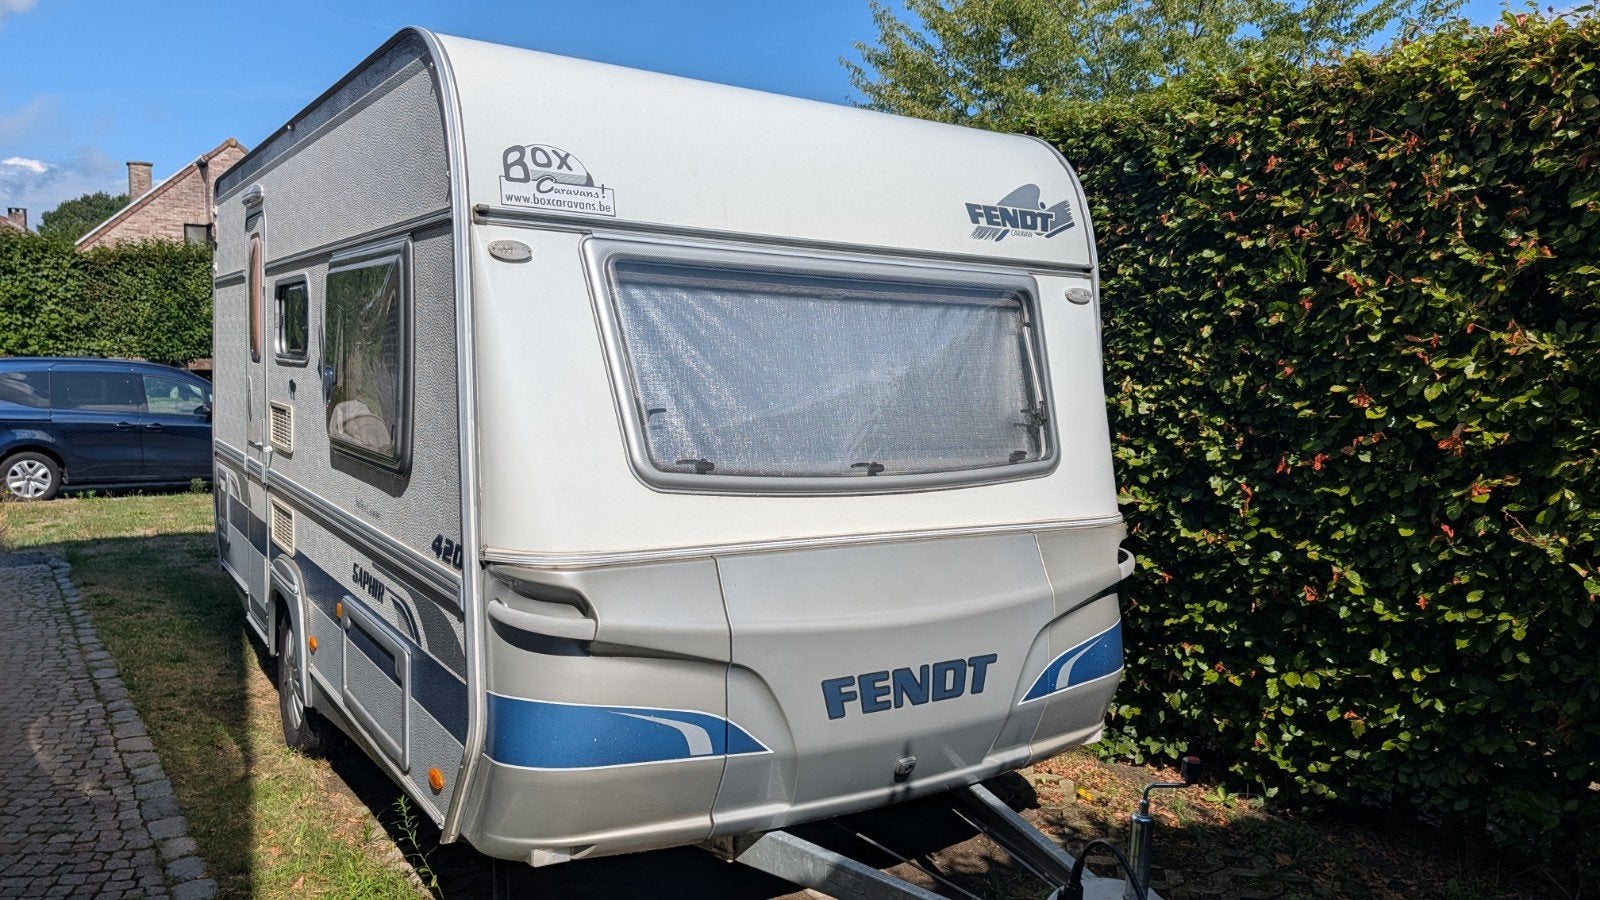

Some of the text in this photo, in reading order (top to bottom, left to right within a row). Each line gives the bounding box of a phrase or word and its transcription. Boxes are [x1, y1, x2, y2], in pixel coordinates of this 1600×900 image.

[505, 193, 611, 212] www.boxcaravans.be
[965, 202, 1054, 233] FENDT
[352, 562, 385, 604] SAPHIR
[821, 653, 997, 720] FENDT
